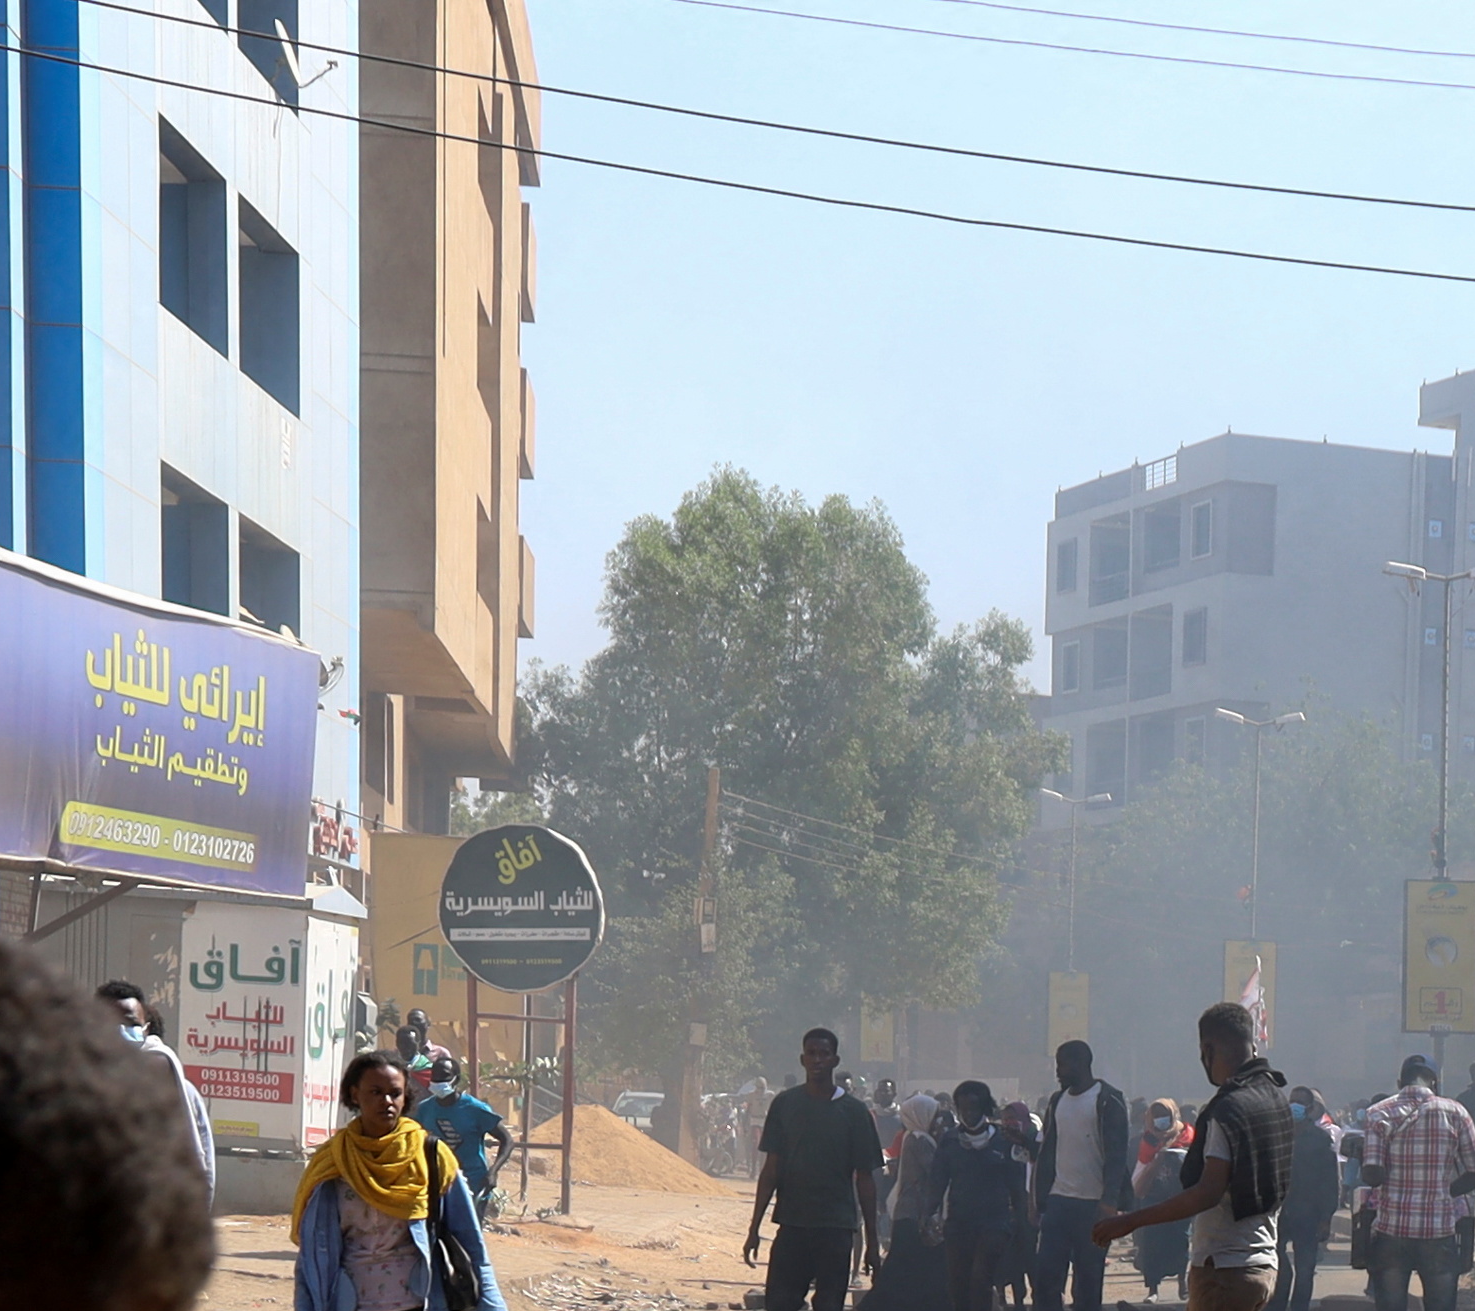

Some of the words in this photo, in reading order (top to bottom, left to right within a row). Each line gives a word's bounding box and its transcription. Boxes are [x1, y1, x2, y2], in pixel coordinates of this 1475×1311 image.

[85, 628, 171, 716] للثياب
[179, 664, 267, 748] إيرائي
[95, 725, 165, 774] الثياب
[167, 746, 249, 797] وتطقيم
[68, 810, 161, 848] 0912463290
[173, 829, 255, 865] 0123102726
[494, 834, 543, 885] آفاق
[445, 889, 545, 917] السويسرية
[549, 886, 594, 917] للثياب
[189, 938, 303, 992] آفاق
[205, 1000, 284, 1029] للثياب
[186, 1027, 295, 1058] السويسرية
[200, 1067, 280, 1087] 0911319500
[200, 1083, 280, 1102] 0123519500
